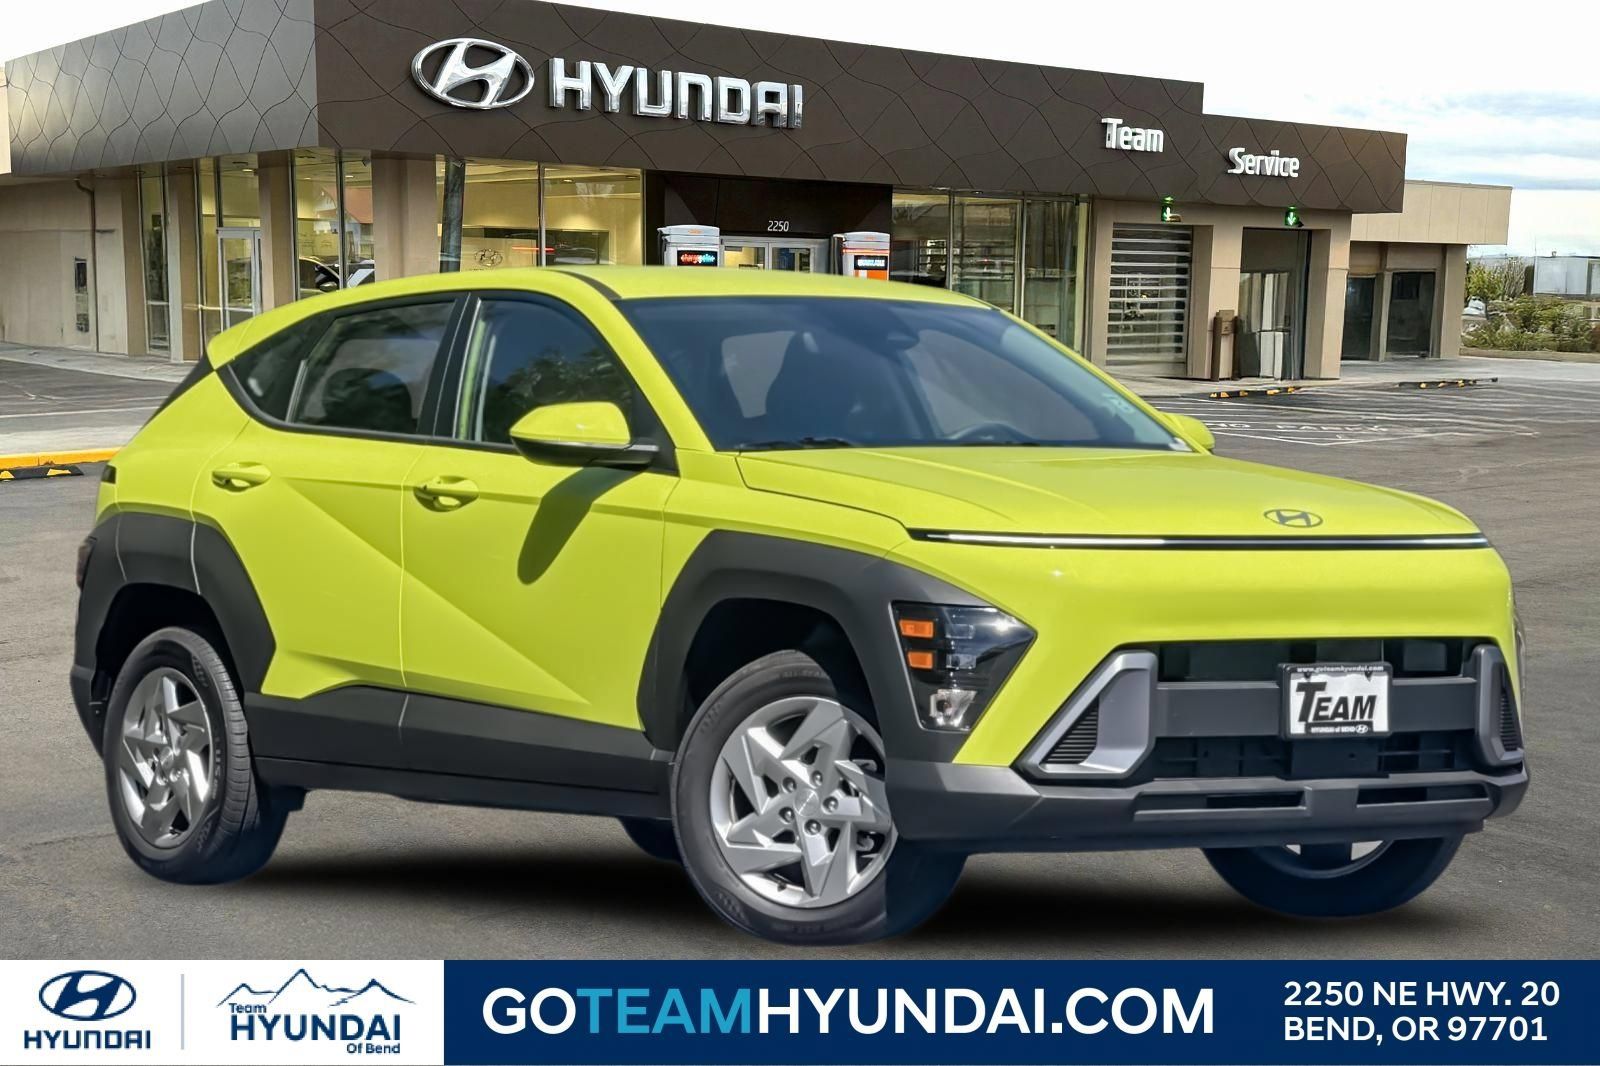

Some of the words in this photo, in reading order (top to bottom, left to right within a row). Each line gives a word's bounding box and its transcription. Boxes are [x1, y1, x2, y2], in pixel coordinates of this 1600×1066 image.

[549, 57, 803, 129] HYUNDAI
[1101, 117, 1164, 153] Team
[1227, 147, 1300, 178] Service
[767, 220, 790, 232] 2250
[1295, 681, 1378, 722] TEAM
